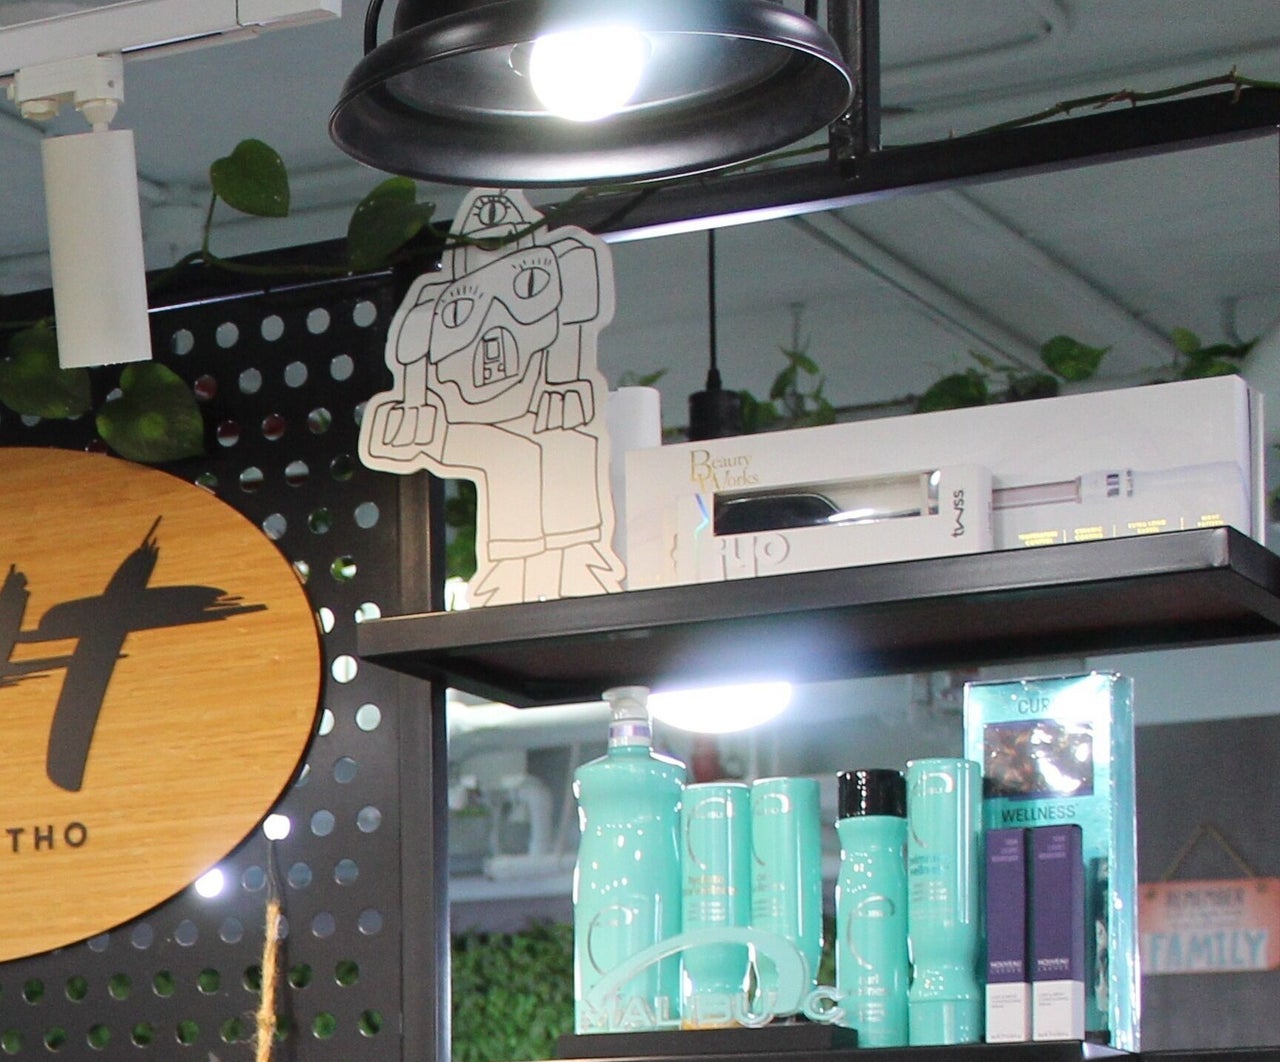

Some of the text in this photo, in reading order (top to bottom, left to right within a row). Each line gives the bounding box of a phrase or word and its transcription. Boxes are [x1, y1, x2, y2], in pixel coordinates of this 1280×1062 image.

[690, 449, 752, 482] Beauty
[1017, 698, 1053, 715] CUR
[1001, 804, 1076, 823] WELLNESS
[7, 821, 89, 855] THO
[1150, 929, 1268, 968] FAMILY
